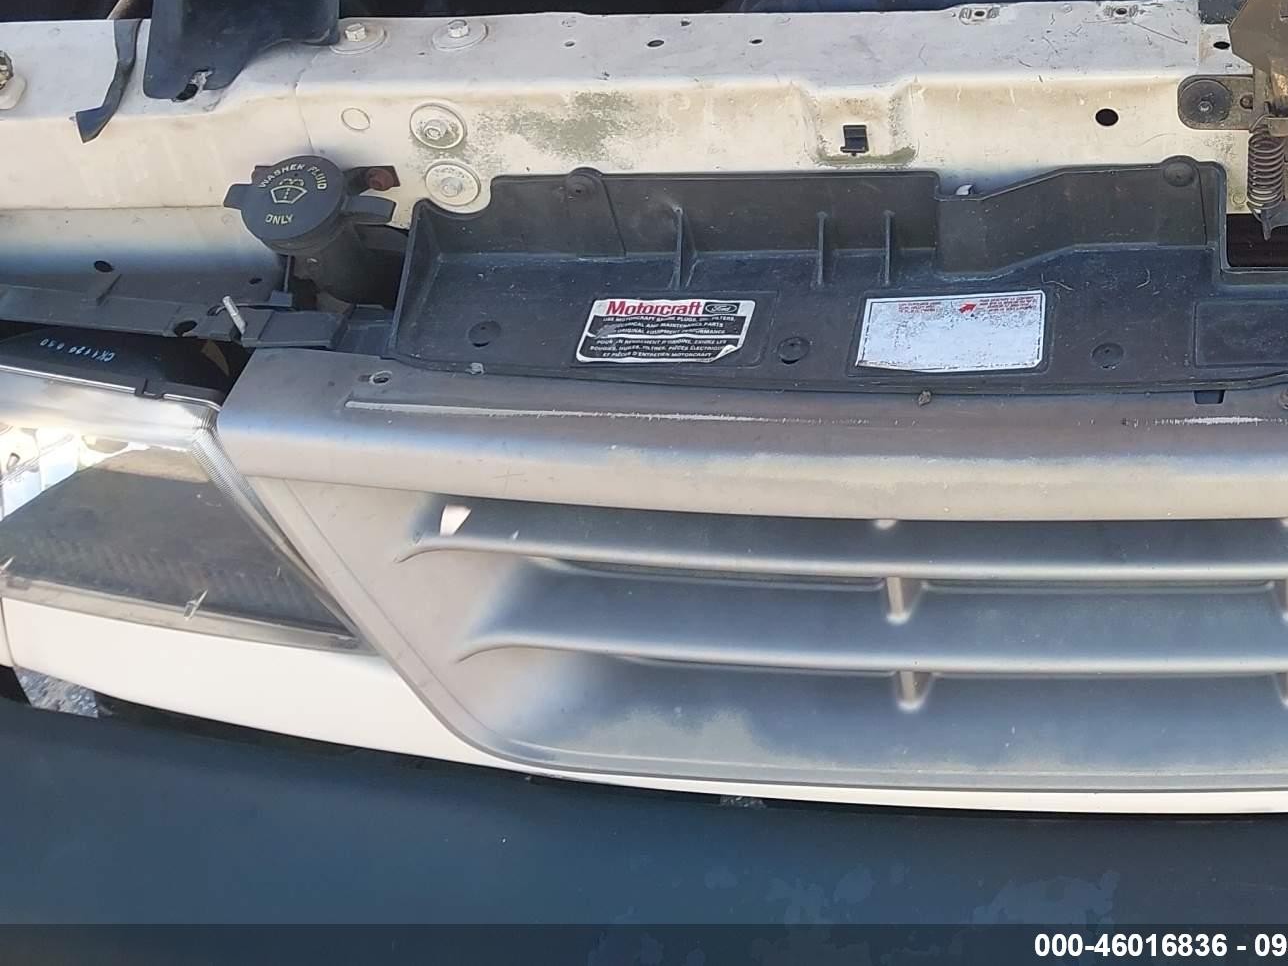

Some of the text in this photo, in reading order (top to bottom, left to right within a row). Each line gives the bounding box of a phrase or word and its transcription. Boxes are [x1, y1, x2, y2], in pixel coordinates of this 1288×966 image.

[259, 163, 328, 191] WASHER FLUID
[265, 213, 294, 225] ONLY
[606, 301, 702, 315] Motorcraft
